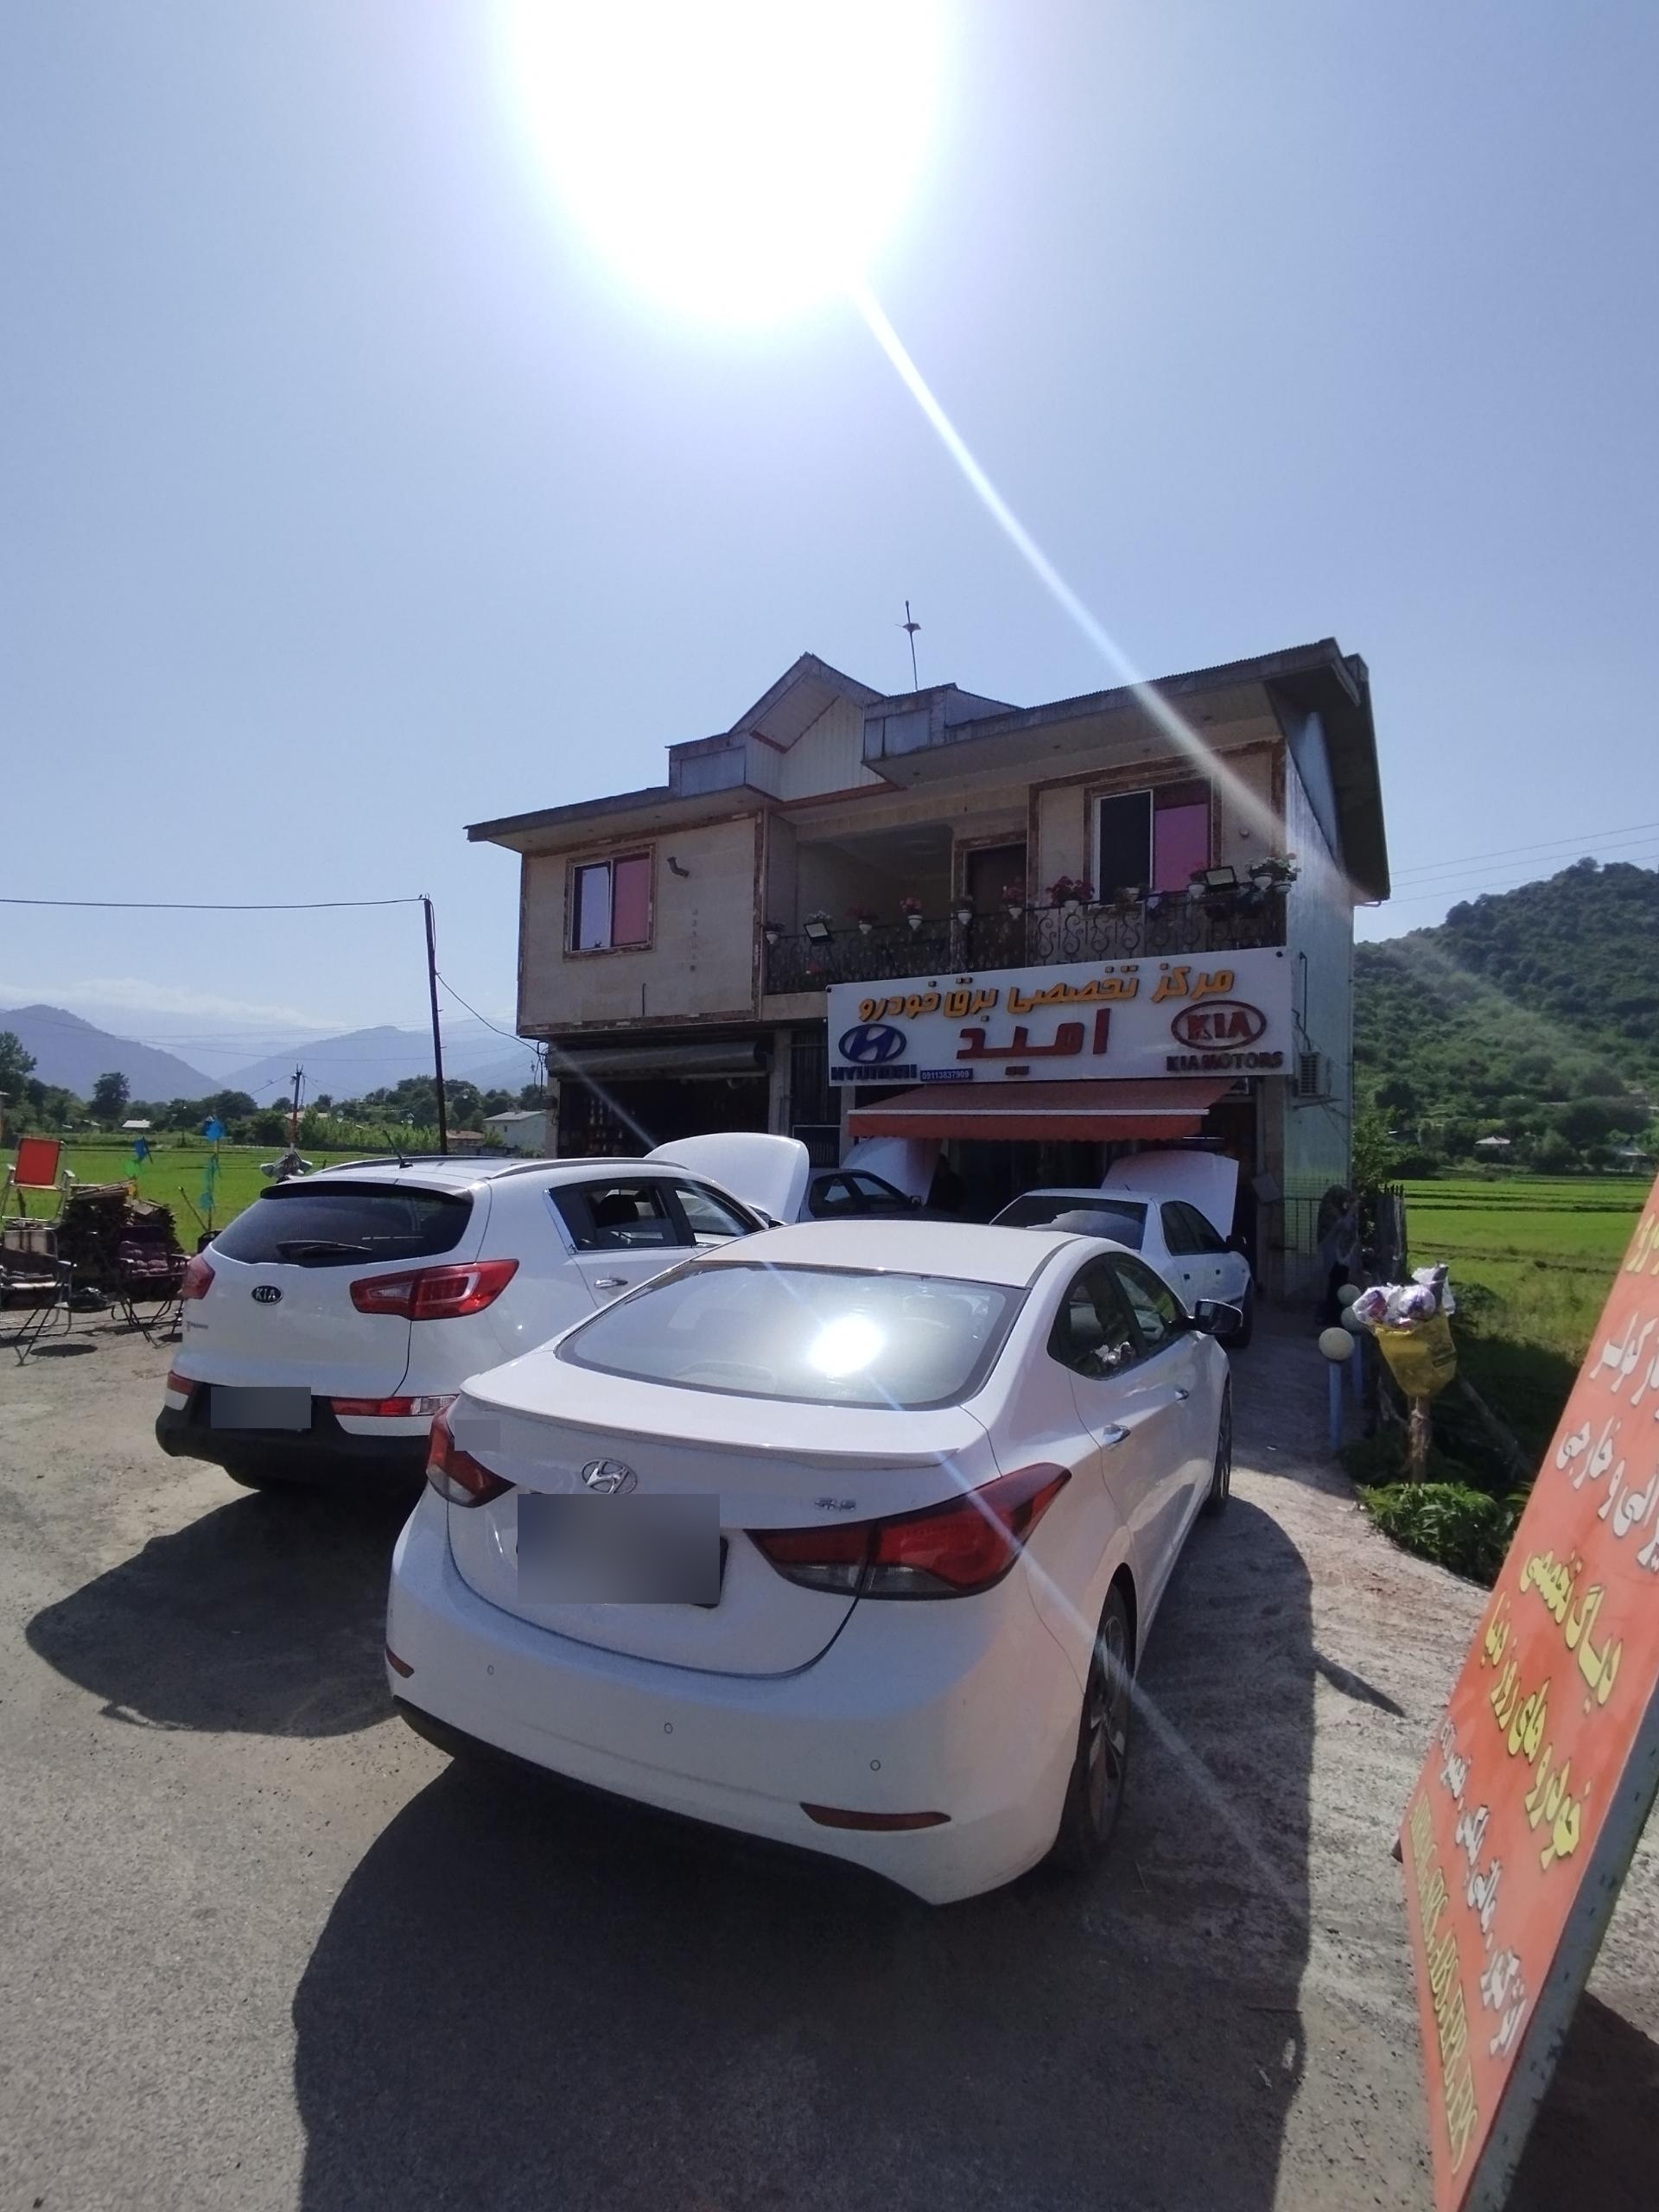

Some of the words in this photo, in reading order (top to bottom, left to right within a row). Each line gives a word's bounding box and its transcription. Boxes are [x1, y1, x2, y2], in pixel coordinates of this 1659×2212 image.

[858, 980, 942, 1022] خودرو
[944, 977, 999, 1023] برق
[1007, 964, 1140, 1014] تخصصی
[1151, 963, 1236, 1003] مرکز
[956, 1007, 1111, 1076] امید
[1186, 1011, 1253, 1039] KIA
[830, 1064, 918, 1081] HYUI
[256, 1287, 276, 1300] KIA
[1589, 1312, 1658, 1393] کولر
[1556, 1415, 1621, 1491] خارجی
[1598, 1459, 1625, 1521] و
[1520, 1549, 1583, 1624] تخصصی
[1479, 1592, 1511, 1667] دنیا
[1565, 1585, 1623, 1715] دیاگ
[1491, 1637, 1522, 1731] روز
[1508, 1678, 1552, 1764] های
[1525, 1743, 1592, 1871] خودرو
